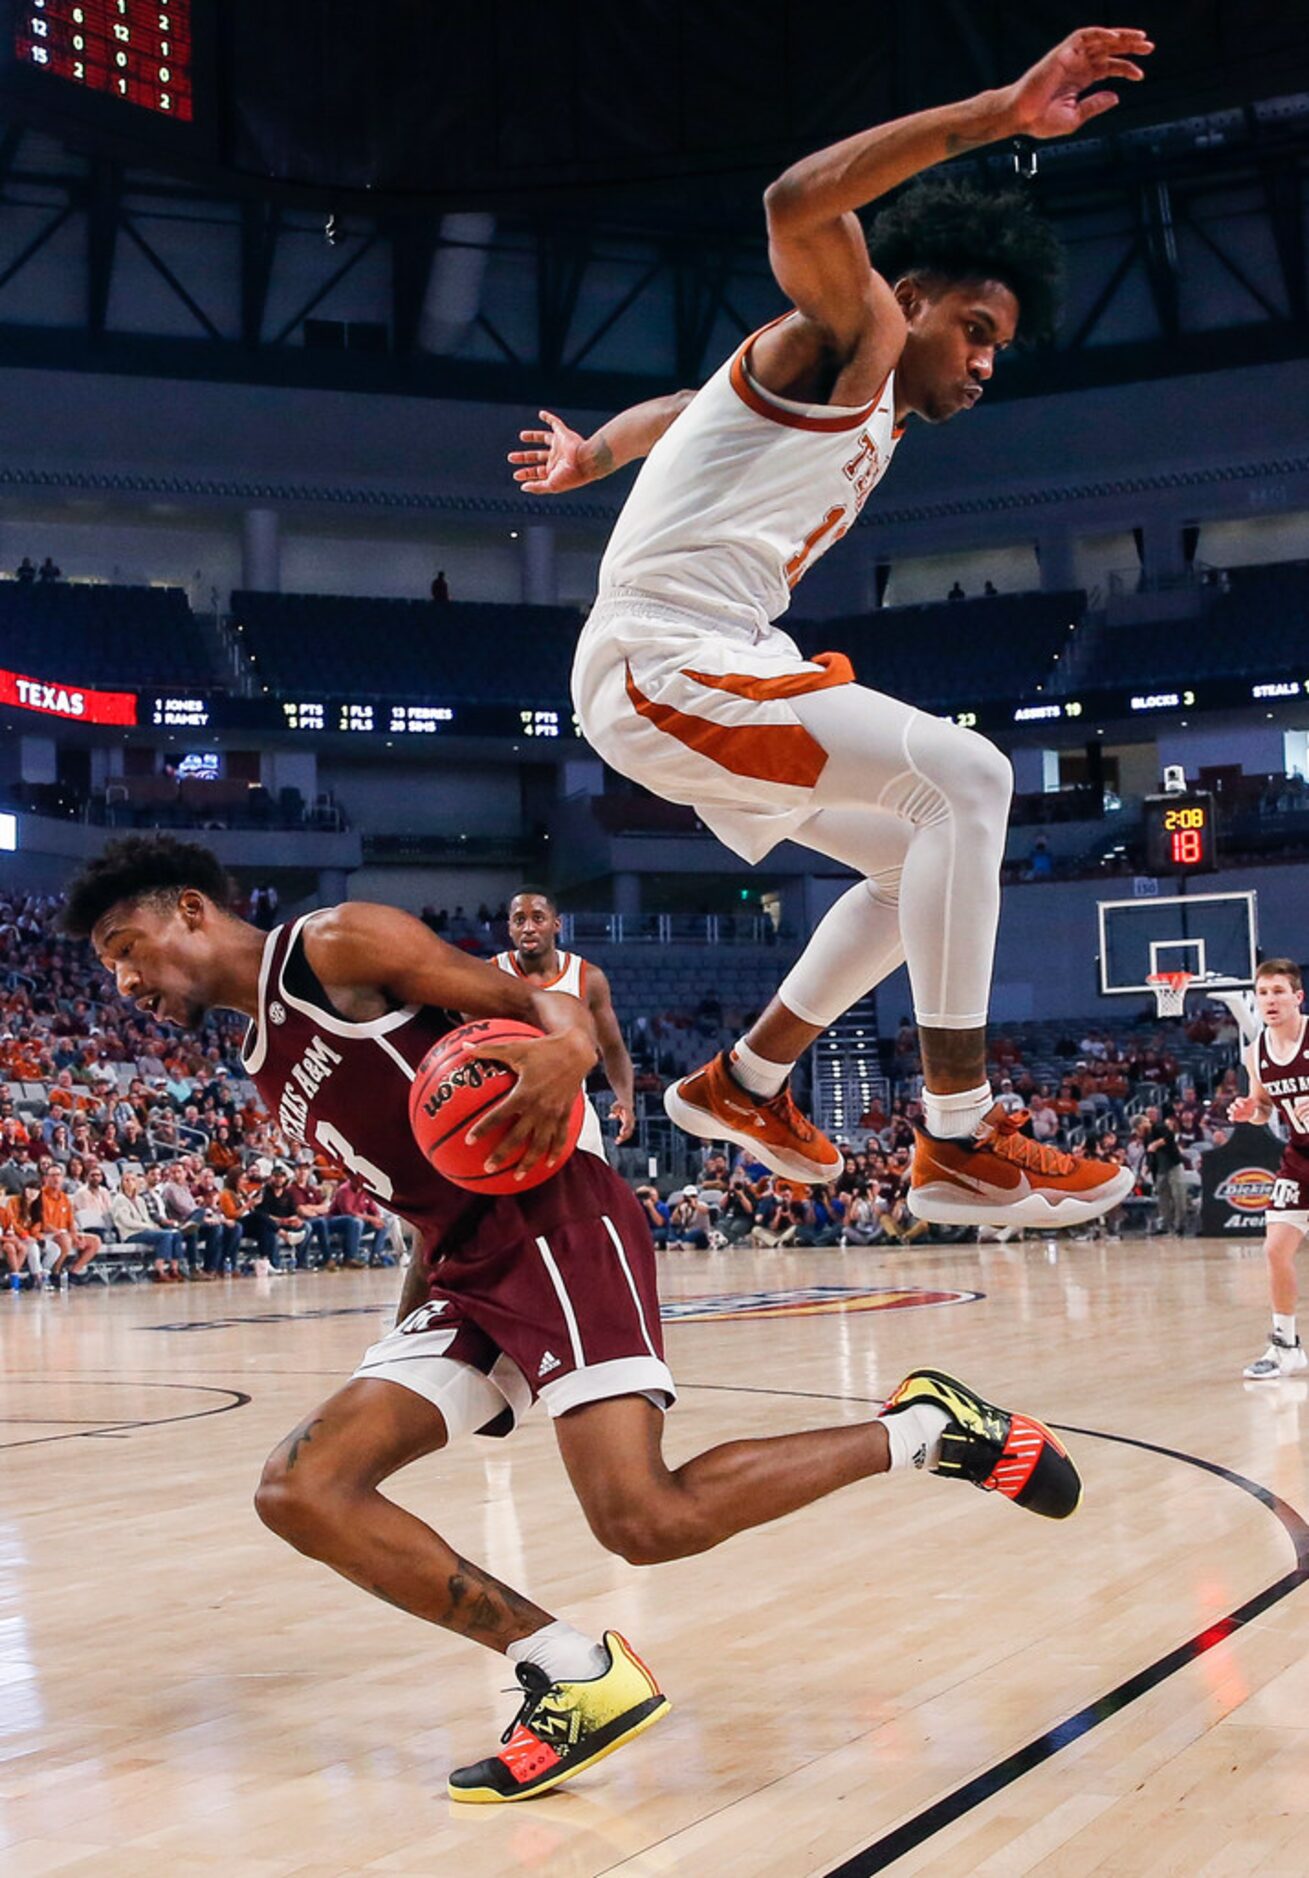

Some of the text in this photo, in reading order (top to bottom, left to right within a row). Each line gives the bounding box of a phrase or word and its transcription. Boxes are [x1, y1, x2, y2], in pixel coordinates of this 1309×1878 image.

[159, 14, 169, 30] 2
[73, 8, 169, 57] 6 12 1
[31, 17, 170, 83] 12 0 0 0
[31, 45, 170, 109] 15 2 1 2
[16, 680, 84, 715] TEXAS
[1252, 682, 1300, 698] STEALS
[155, 699, 205, 713] 1 JONES
[1131, 691, 1195, 710] BLOCKS 3
[283, 703, 324, 716] 10 PTS
[341, 705, 374, 718] 1 FLS
[534, 711, 558, 724] PTS
[153, 712, 209, 726] 3 RAMEY
[289, 716, 324, 729] 5 PTS
[340, 718, 374, 731] 2 FLS
[957, 713, 976, 727] 23
[523, 724, 559, 737] 4 PTS
[1164, 808, 1204, 830] 2:08
[1172, 830, 1201, 864] 18
[291, 1035, 343, 1100] A&M
[315, 1120, 394, 1202] 3
